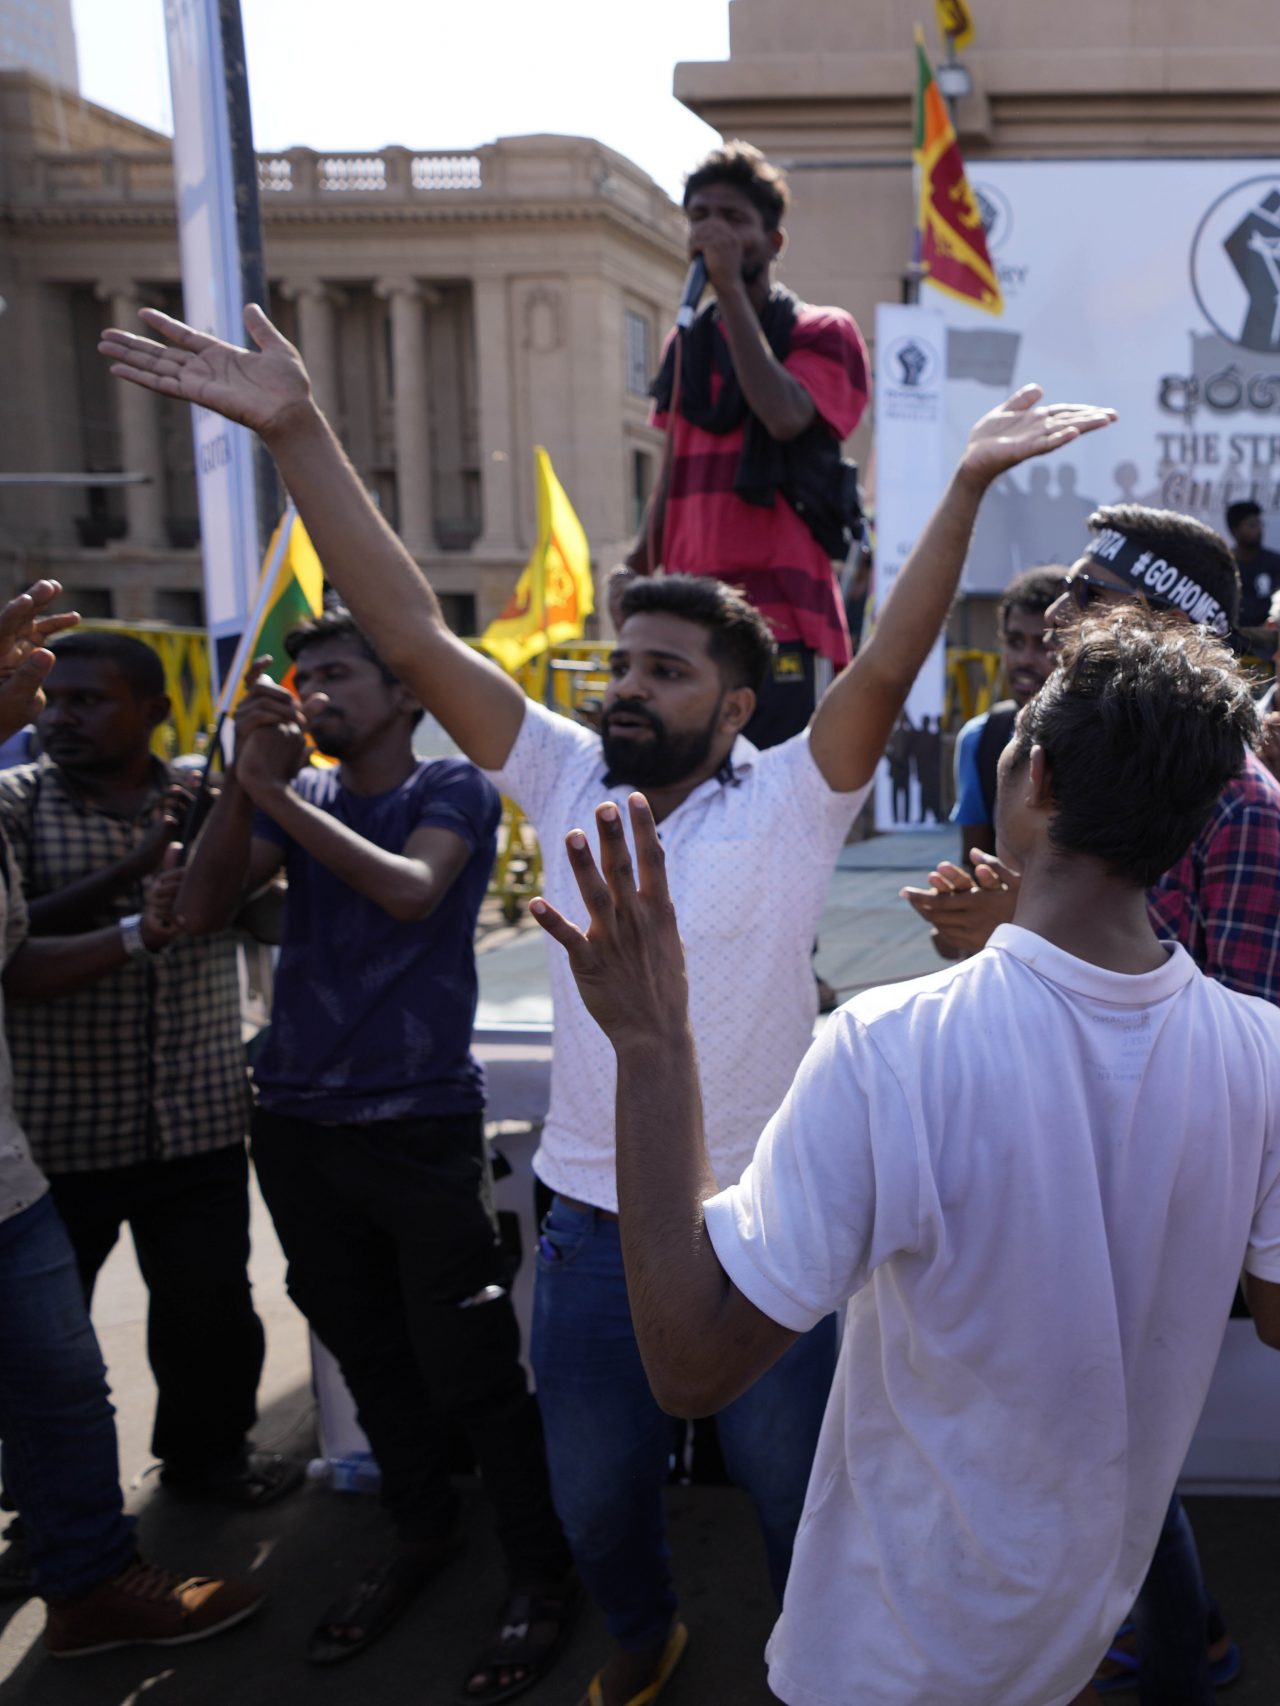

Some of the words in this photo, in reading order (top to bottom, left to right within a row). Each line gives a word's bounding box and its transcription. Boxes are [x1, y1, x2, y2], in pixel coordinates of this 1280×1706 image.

[1155, 433, 1220, 466] THE
[1130, 550, 1178, 594] #GO
[1167, 575, 1220, 625] HOME
